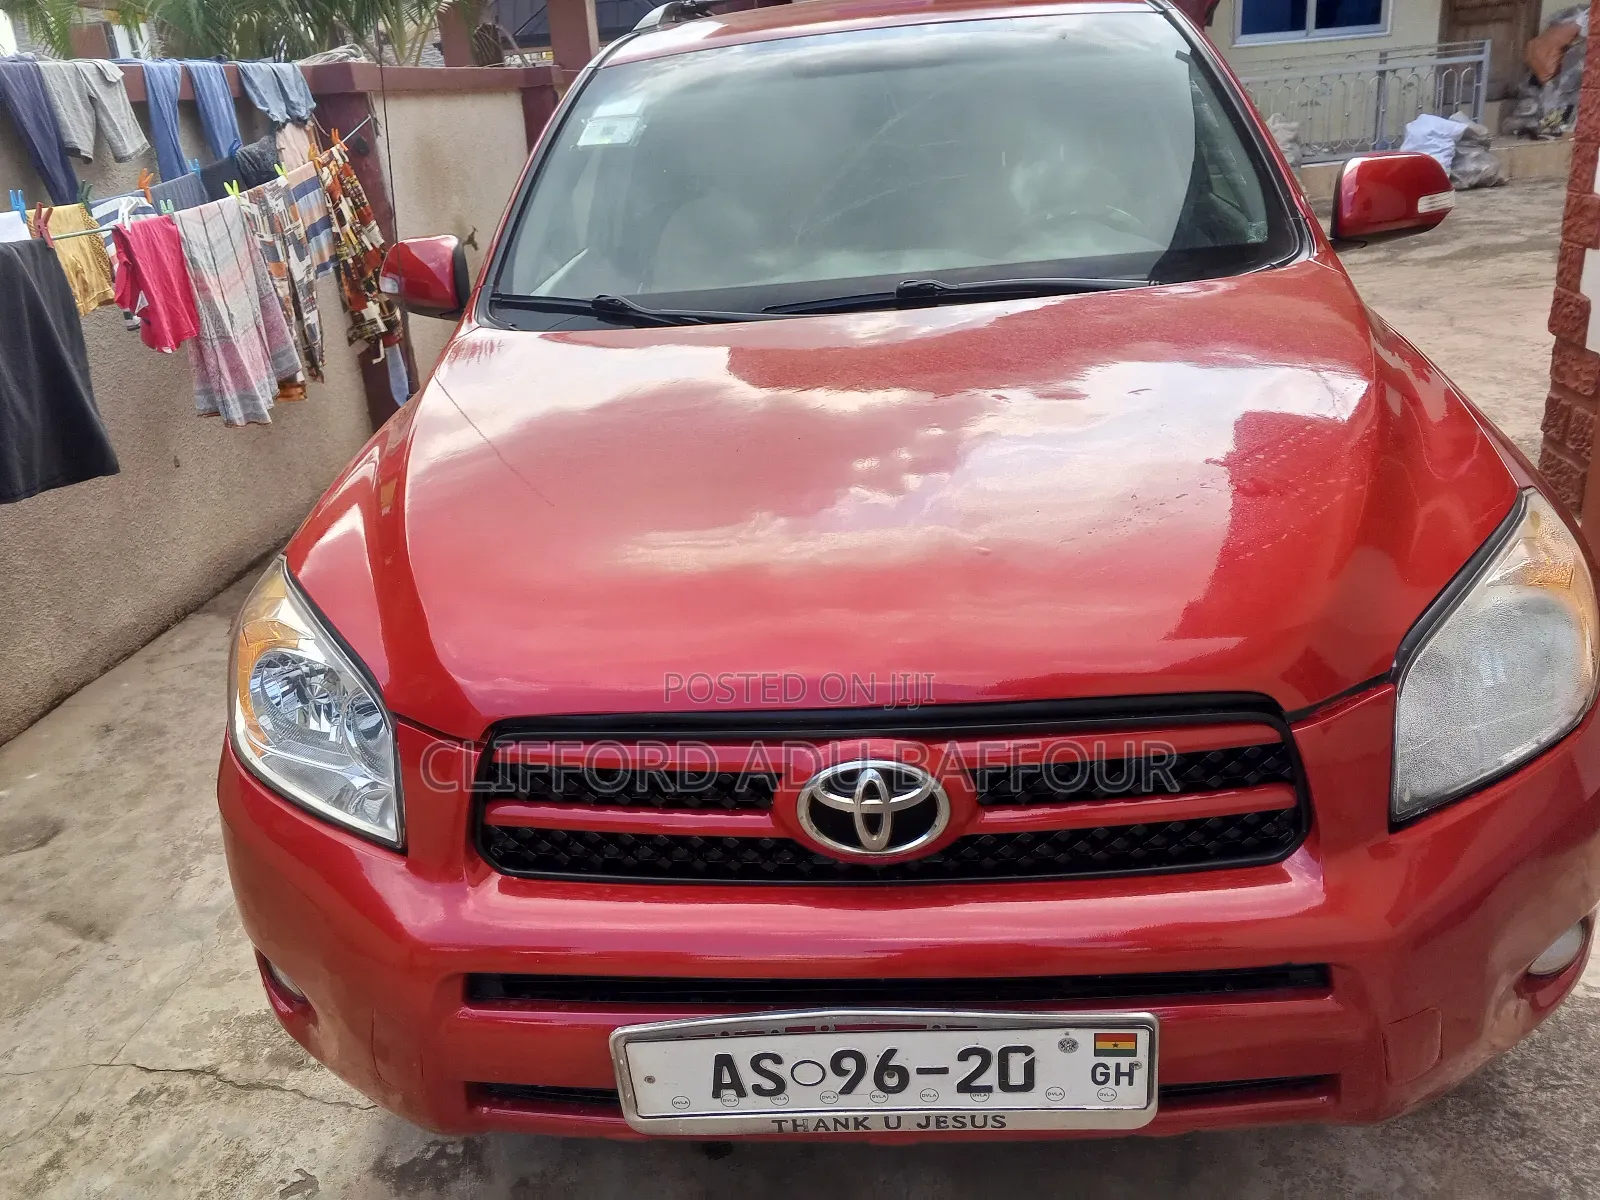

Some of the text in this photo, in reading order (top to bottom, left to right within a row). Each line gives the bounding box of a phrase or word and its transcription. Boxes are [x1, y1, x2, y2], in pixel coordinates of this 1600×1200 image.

[1091, 1062, 1135, 1086] GH
[771, 1114, 1007, 1133] THANK U JESUS
